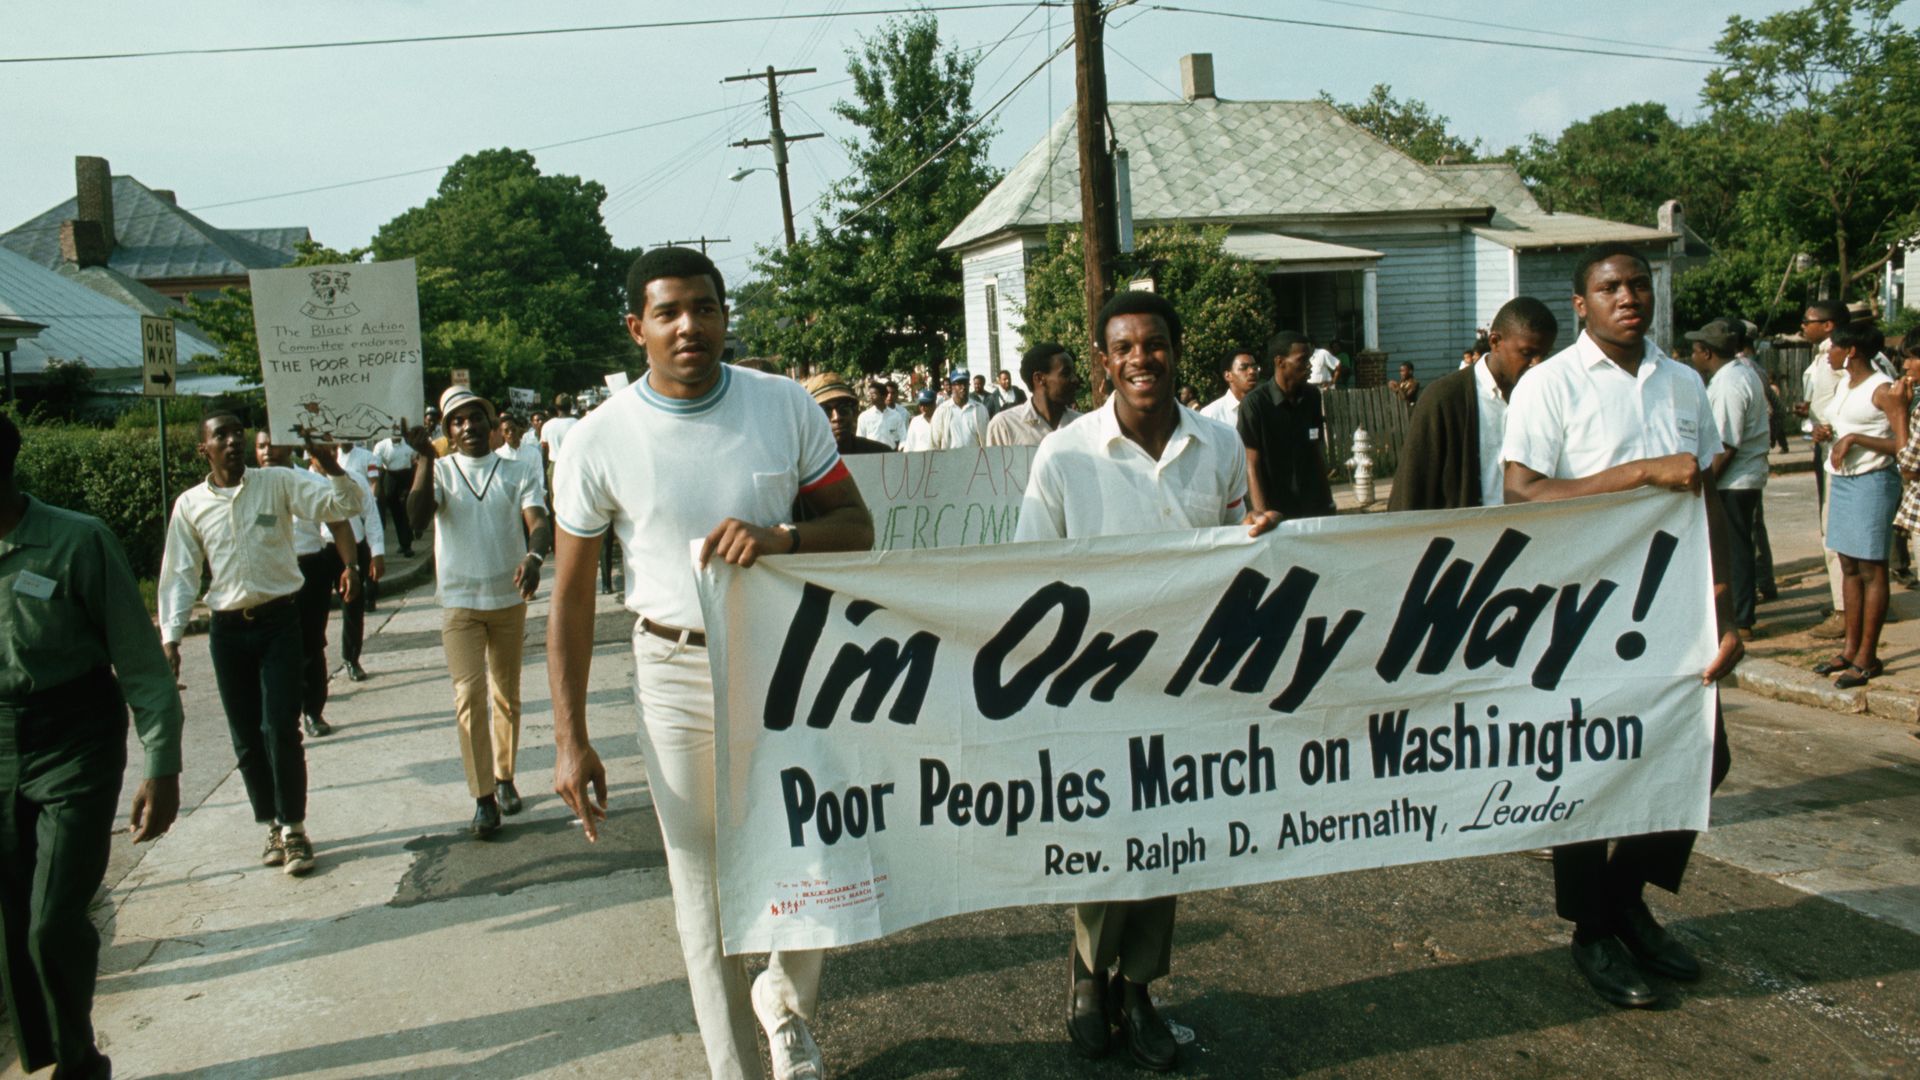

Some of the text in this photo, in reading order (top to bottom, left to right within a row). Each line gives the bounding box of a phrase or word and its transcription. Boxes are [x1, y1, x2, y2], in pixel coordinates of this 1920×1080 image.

[146, 323, 171, 342] ONE
[271, 322, 405, 337] The Black Action
[148, 346, 172, 364] WAY
[279, 338, 408, 354] Committee endorses
[269, 359, 302, 373] THE
[310, 357, 349, 371] POOR
[317, 373, 370, 387] MARCH
[882, 450, 947, 500] WE
[764, 581, 941, 732] I'm
[972, 580, 1159, 721] On
[1163, 565, 1366, 714] My
[780, 698, 1643, 848] Poor Peoples March on Washington
[1045, 843, 1111, 876] Rev.
[1126, 827, 1206, 875] Ralph
[1228, 820, 1259, 858] D.
[1458, 779, 1586, 834] Leader
